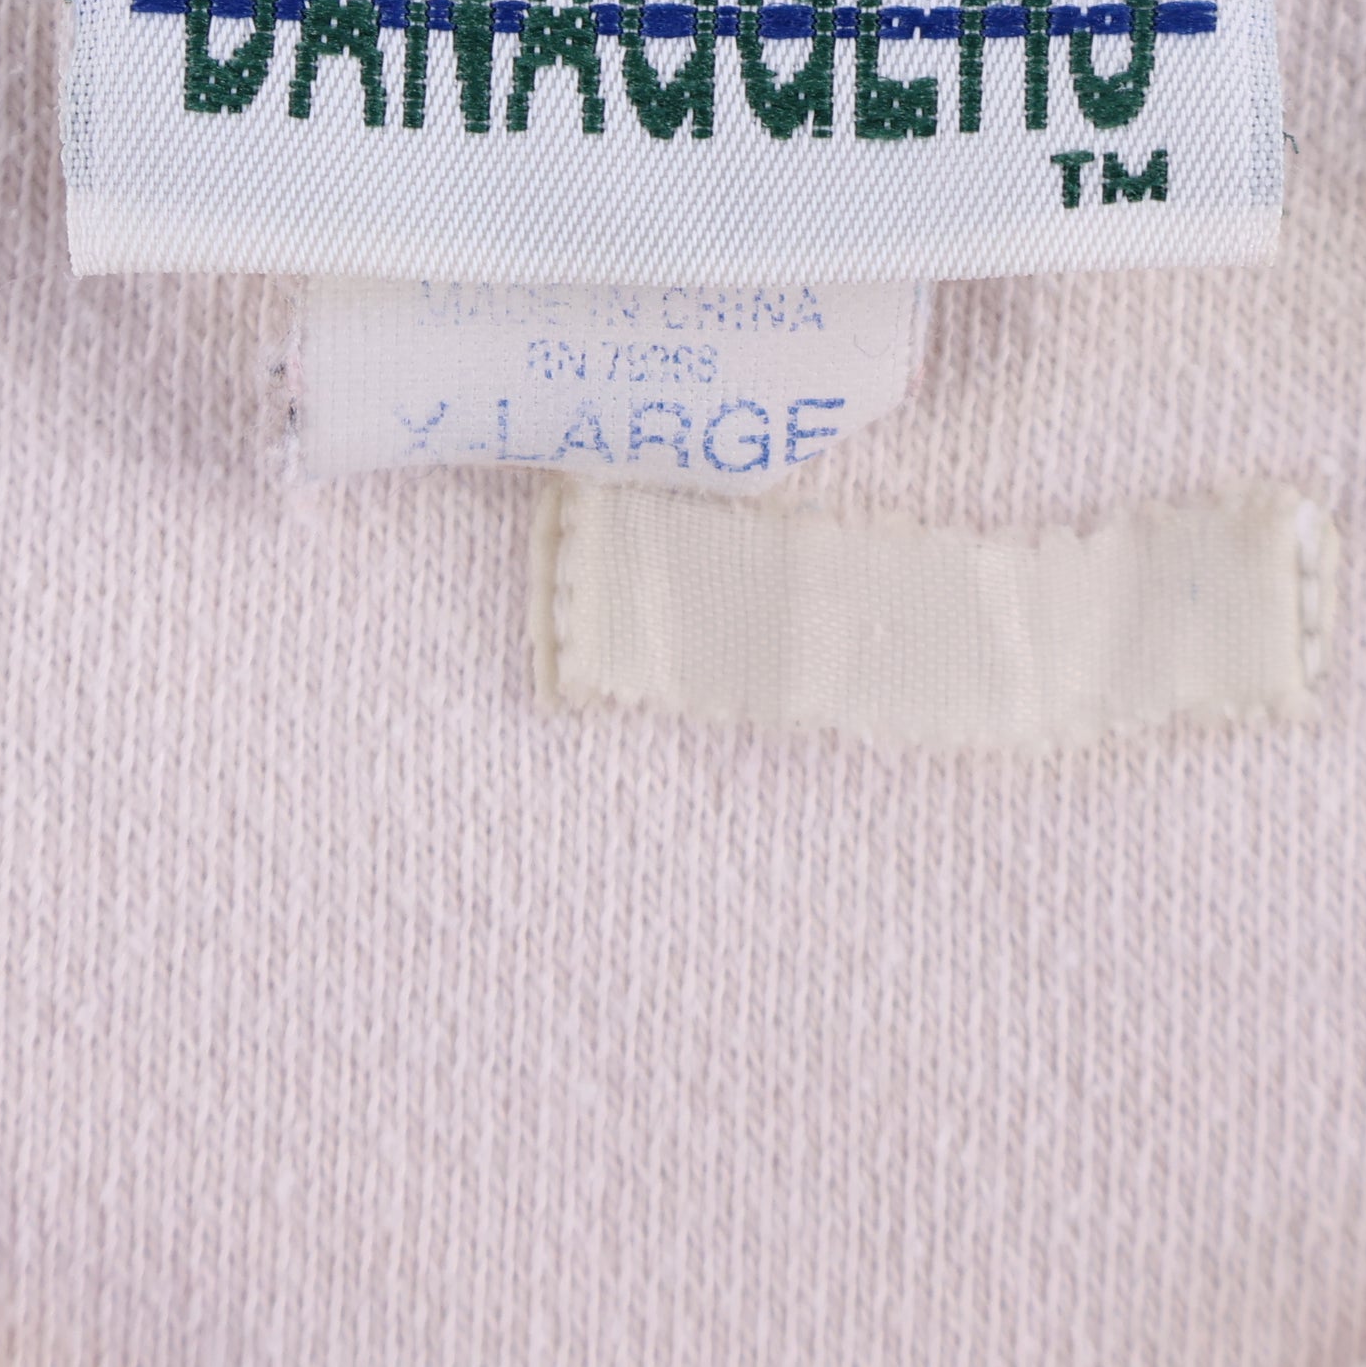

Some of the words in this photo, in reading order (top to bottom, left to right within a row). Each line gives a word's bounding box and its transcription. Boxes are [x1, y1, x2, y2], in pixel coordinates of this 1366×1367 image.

[1050, 148, 1169, 209] TM
[662, 286, 826, 332] CHINA
[528, 338, 586, 380] RN
[394, 397, 847, 473] X-LARGE
